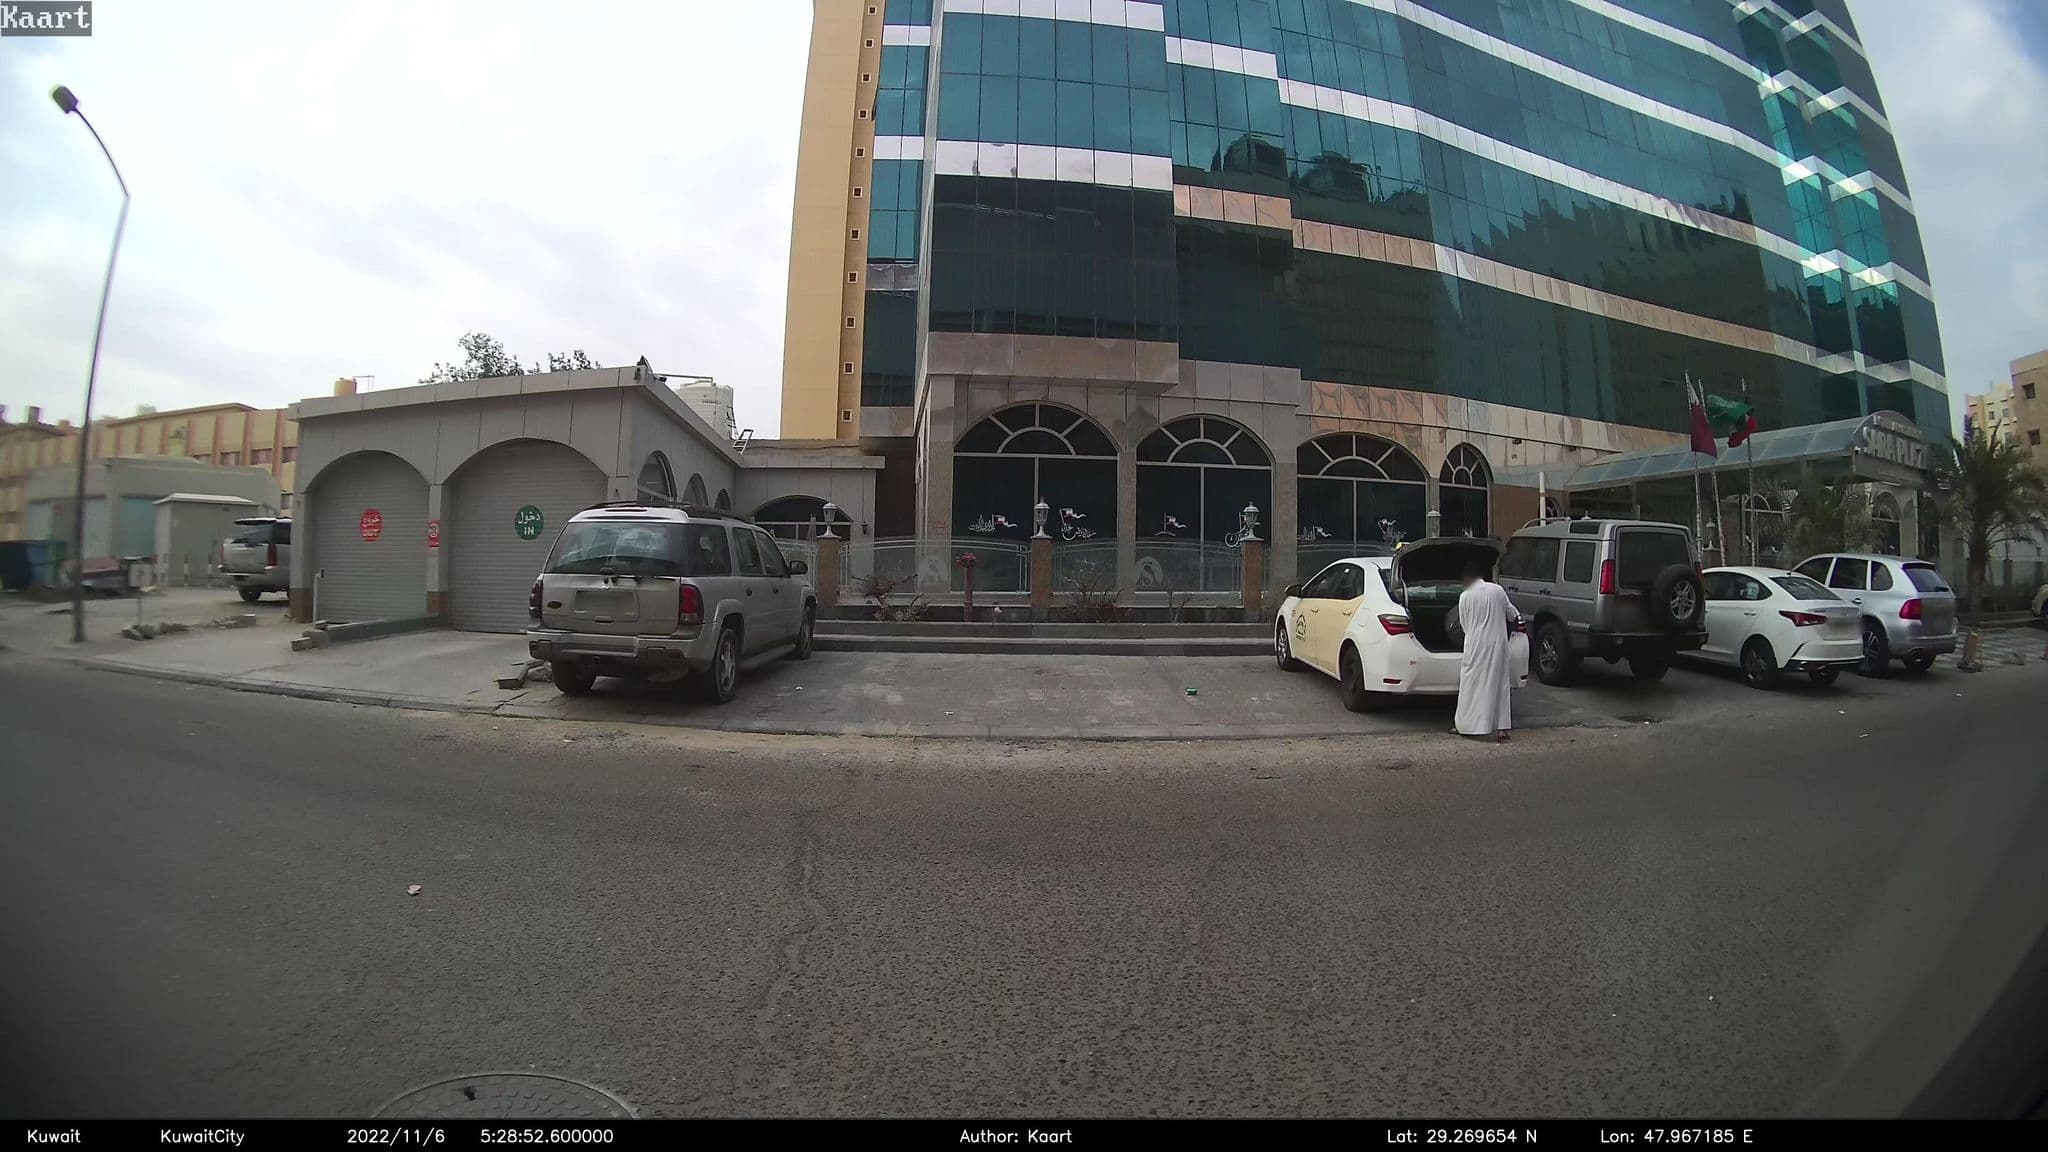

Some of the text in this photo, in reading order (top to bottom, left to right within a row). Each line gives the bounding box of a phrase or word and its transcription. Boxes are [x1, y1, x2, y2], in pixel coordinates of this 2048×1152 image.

[517, 511, 541, 525] دخول
[363, 528, 380, 538] OUT
[523, 526, 536, 536] IN
